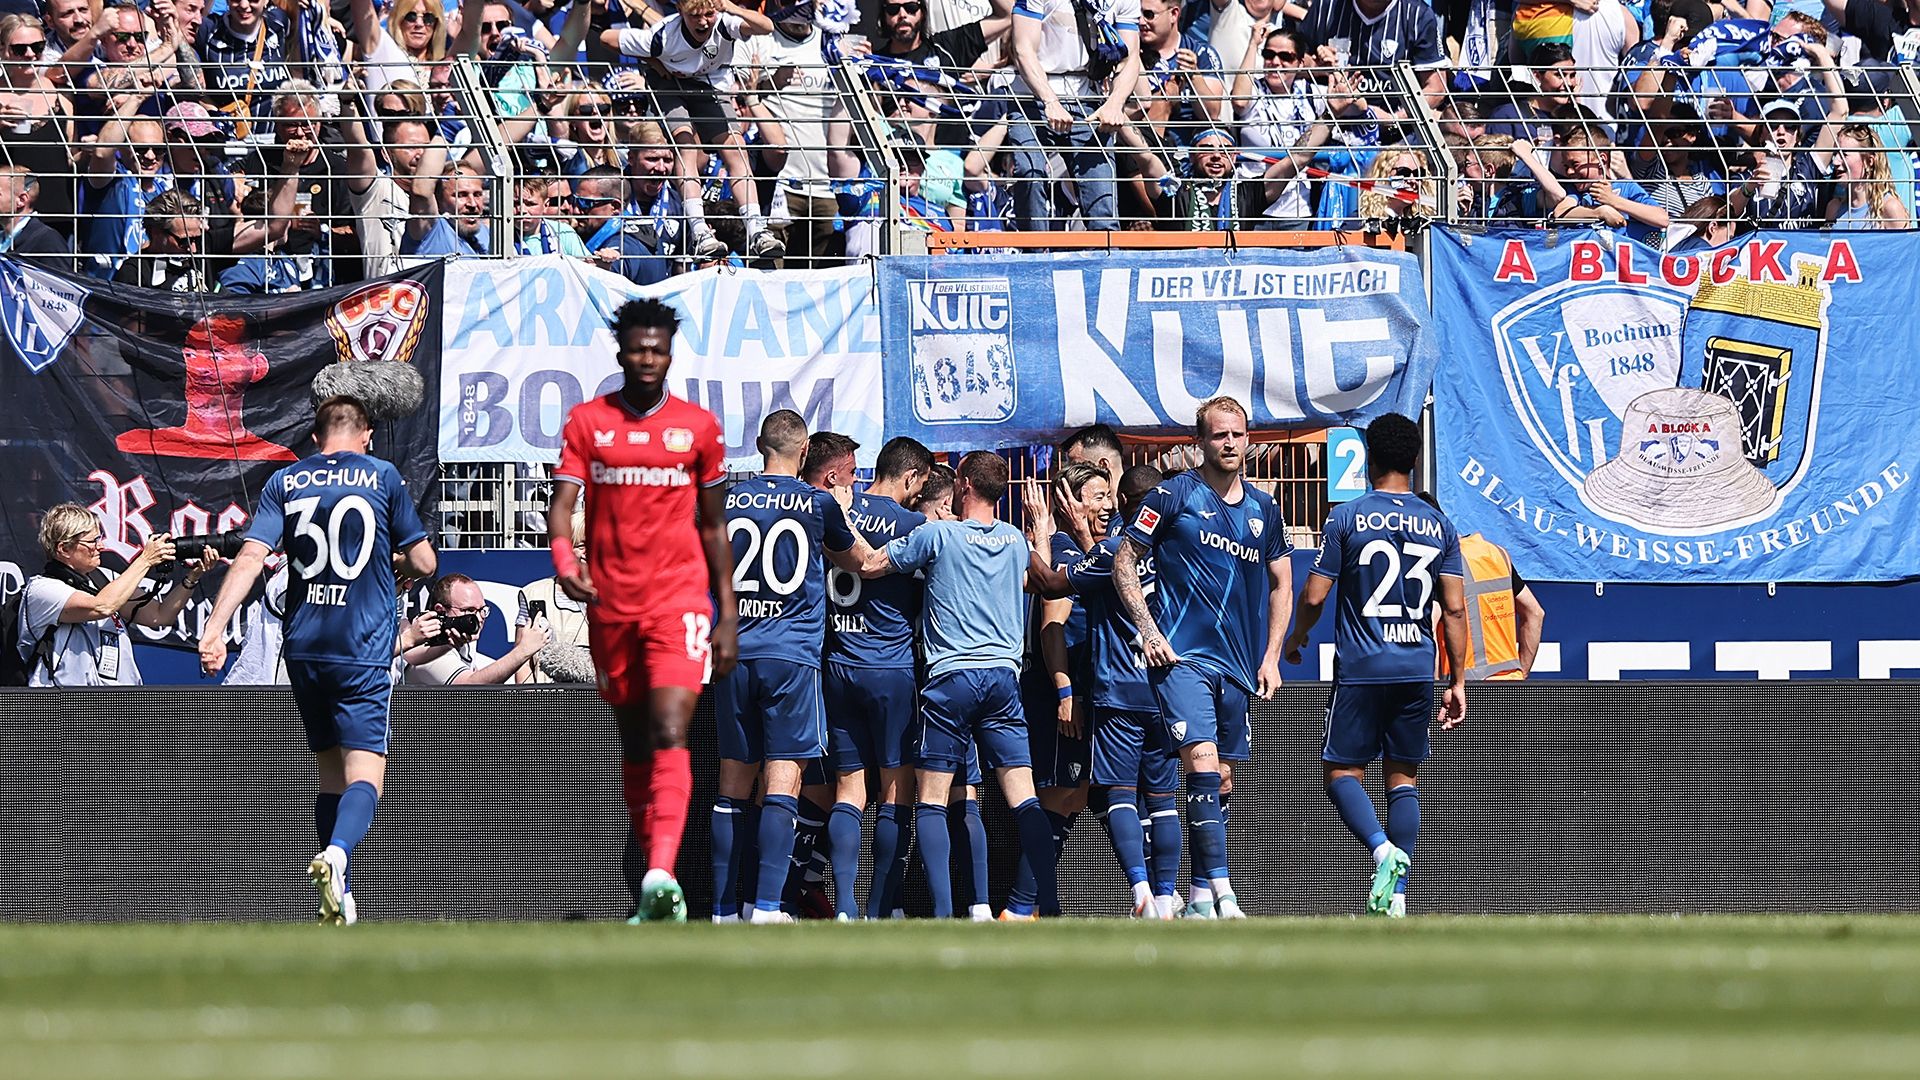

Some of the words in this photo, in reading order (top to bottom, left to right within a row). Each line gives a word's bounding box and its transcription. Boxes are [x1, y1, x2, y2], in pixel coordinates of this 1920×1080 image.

[1494, 240, 1537, 283] A
[1569, 240, 1788, 288] BLOCK
[1822, 240, 1863, 283] A
[939, 285, 953, 293] DER
[1151, 277, 1193, 298] DER
[1202, 269, 1247, 297] VfL
[1254, 272, 1286, 296] IST
[1293, 268, 1387, 296] EINFACH
[40, 299, 68, 313] 1848
[1584, 320, 1672, 348] Bochum
[1608, 352, 1655, 377] 1848
[463, 384, 476, 436] 1848
[1648, 423, 1658, 434] A
[1702, 422, 1711, 433] A
[1334, 438, 1367, 490] 2
[283, 468, 378, 492] BOCHUM
[725, 492, 813, 514] BOCHUM
[1457, 456, 1911, 567] BLAU-WEISSE-FREUNDE
[284, 495, 377, 580] 30
[965, 533, 1018, 546] VONOVIA
[1355, 512, 1442, 540] BOCHUM
[726, 517, 809, 596] 20
[1199, 530, 1260, 563] VONOVIA
[1358, 539, 1442, 620] 23
[739, 599, 783, 618] ORDETS
